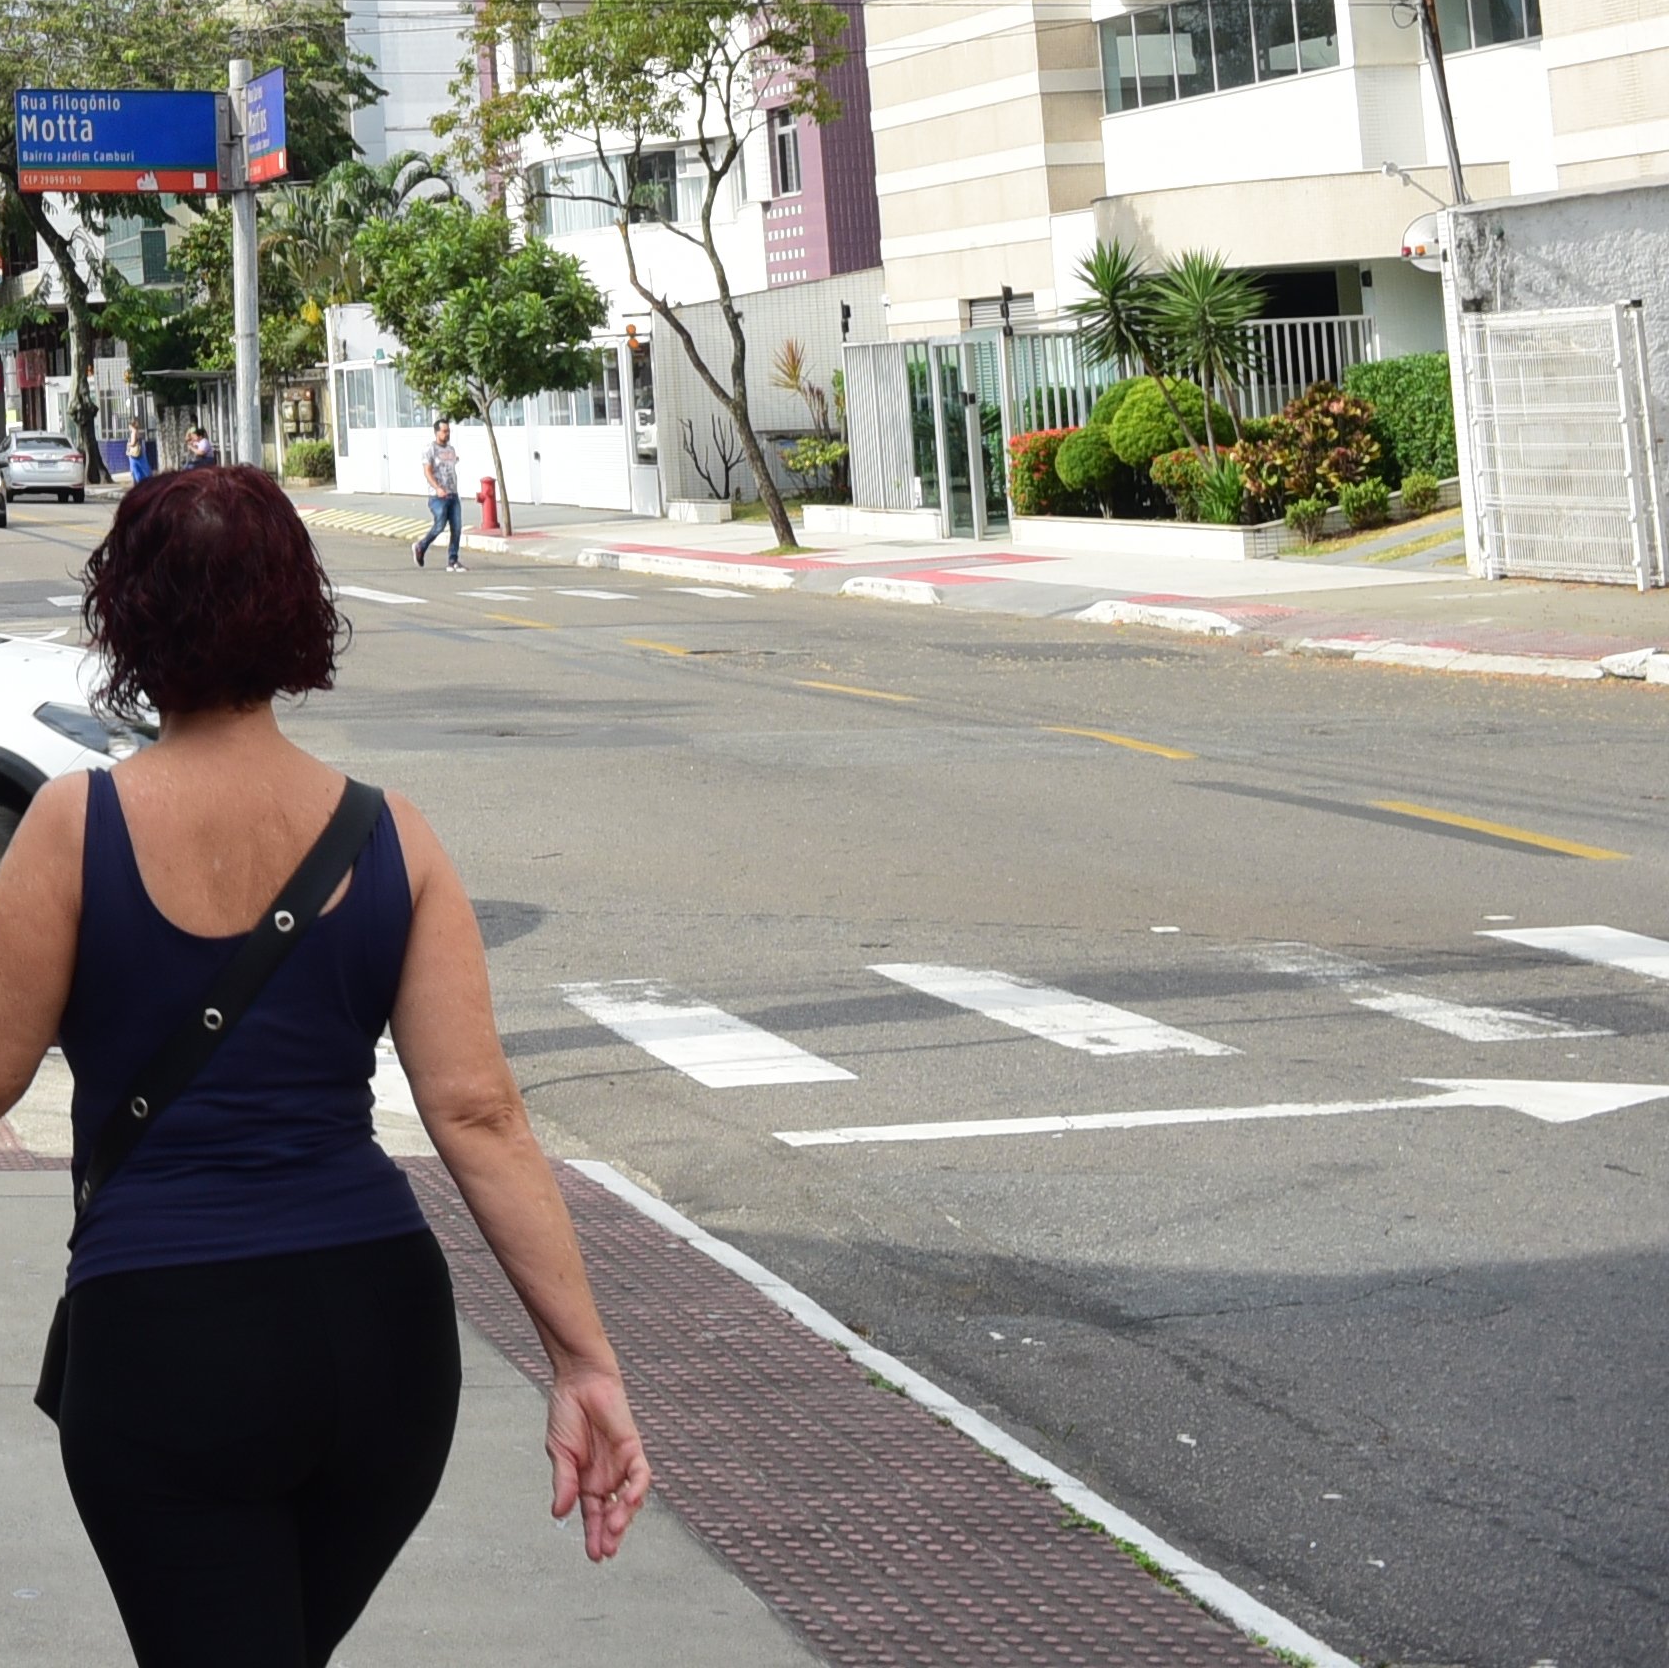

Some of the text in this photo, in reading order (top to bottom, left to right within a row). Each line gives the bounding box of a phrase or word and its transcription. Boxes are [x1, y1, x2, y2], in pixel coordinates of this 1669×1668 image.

[21, 94, 121, 114] Rua Filogônio
[21, 114, 93, 142] Motta
[22, 150, 135, 162] Bairro Jardim Camburi
[23, 175, 38, 185] CEP
